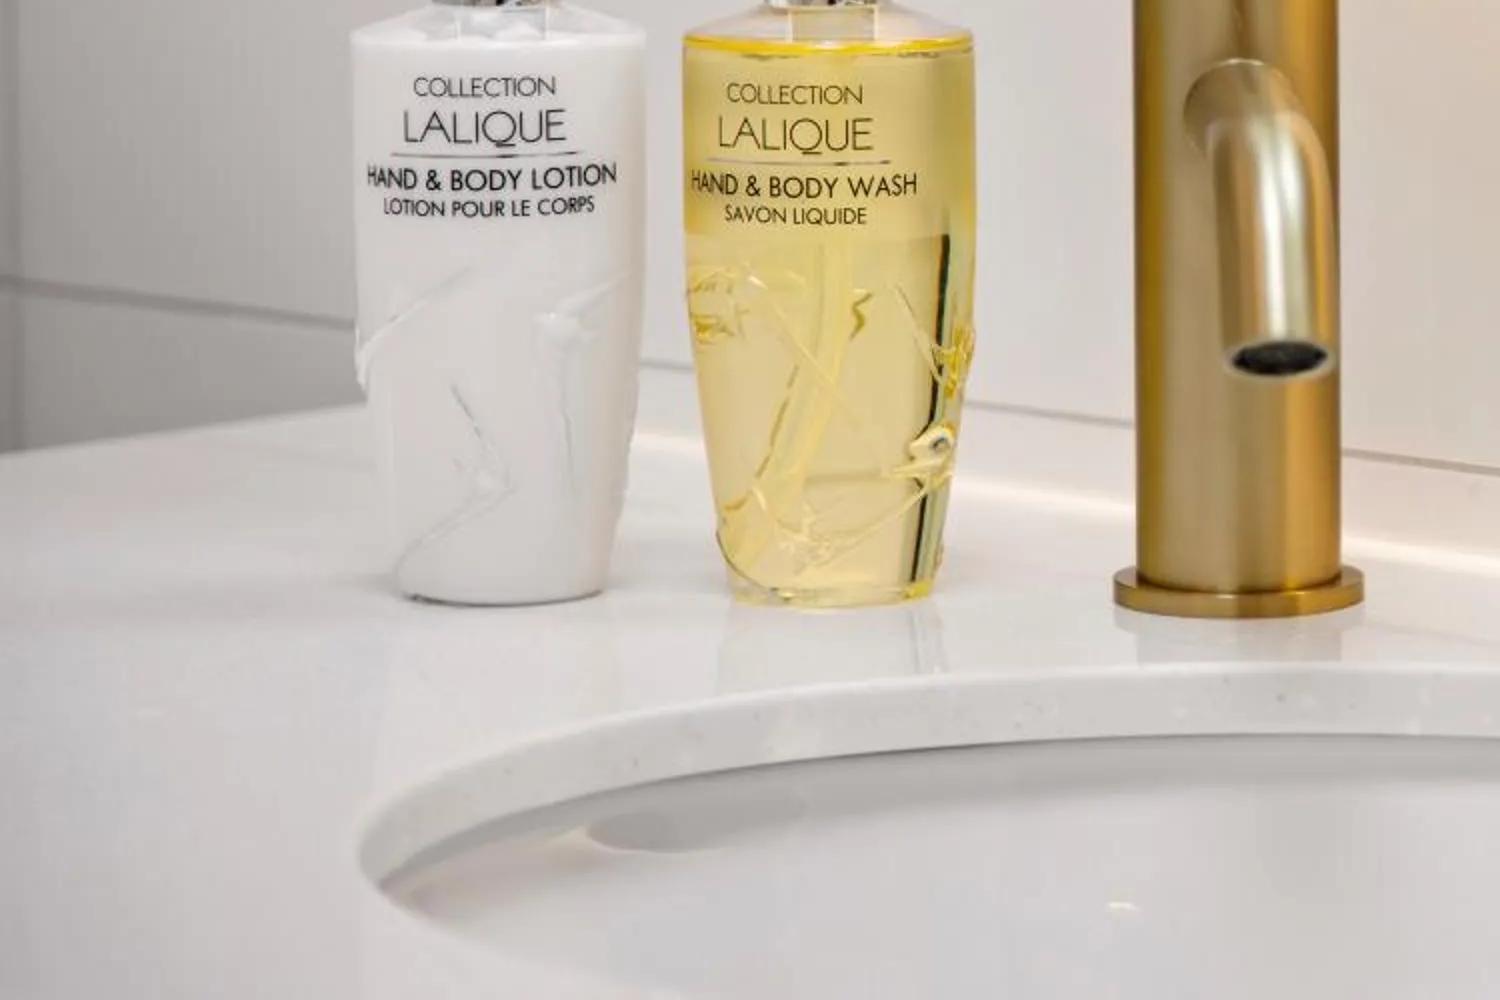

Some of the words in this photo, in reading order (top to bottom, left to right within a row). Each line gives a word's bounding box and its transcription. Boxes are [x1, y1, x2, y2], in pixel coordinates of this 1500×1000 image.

[413, 75, 556, 98] COLLECTION
[726, 82, 863, 105] COLLECTION
[403, 109, 567, 148] LALIQUE
[719, 116, 874, 155] LALIQUE
[367, 163, 417, 191] HAND
[425, 169, 442, 191] &
[450, 168, 522, 192] BODY
[532, 162, 617, 190] LOTION
[691, 170, 738, 196] HAND
[745, 175, 761, 197] &
[769, 176, 838, 199] BODY
[847, 173, 917, 198] WASH
[383, 197, 445, 217] LOTION
[452, 200, 505, 218] POUR
[512, 199, 530, 217] LE
[537, 195, 595, 216] CORPS
[724, 204, 787, 225] SAVON
[793, 206, 867, 226] LIQUIDE
